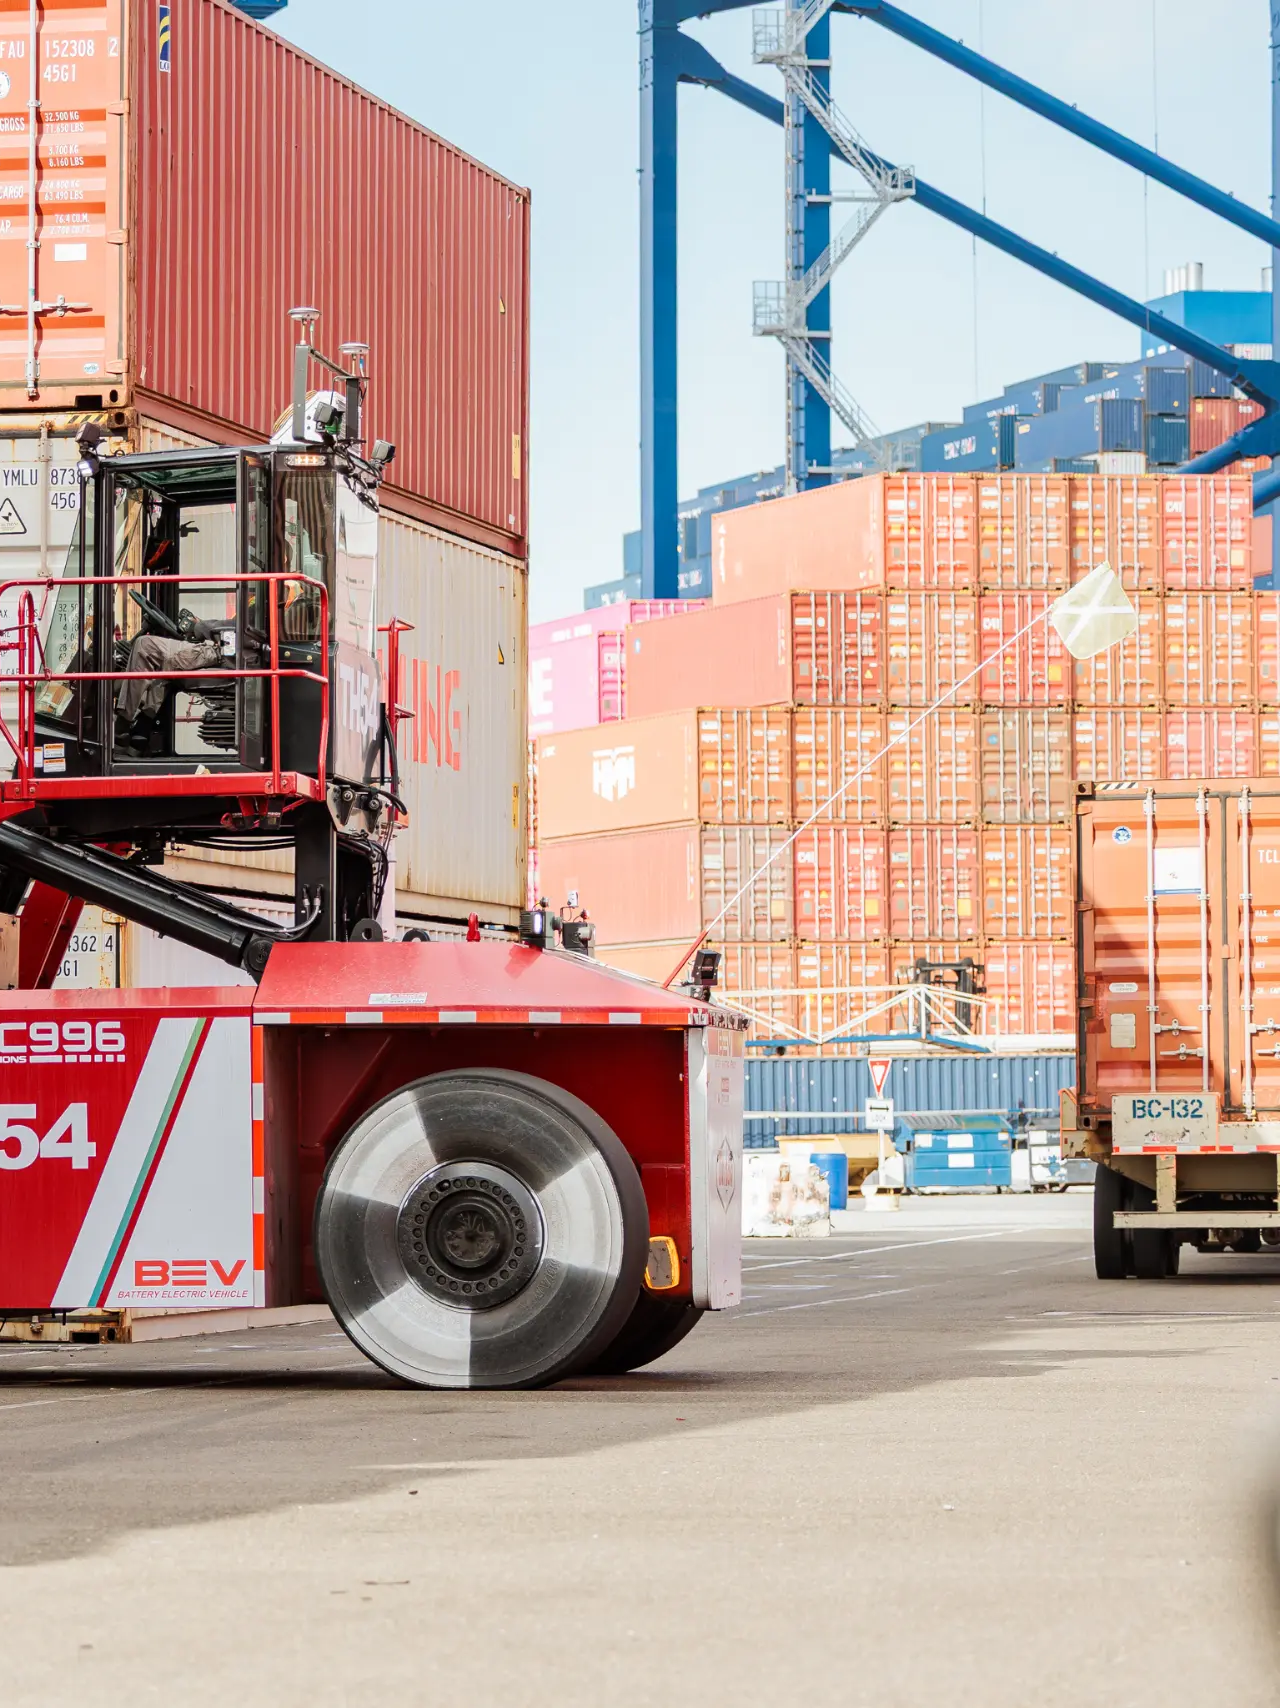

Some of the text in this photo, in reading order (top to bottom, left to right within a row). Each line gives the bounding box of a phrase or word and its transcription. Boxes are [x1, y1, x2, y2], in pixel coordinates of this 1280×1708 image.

[45, 38, 95, 58] 152308
[109, 38, 118, 56] 2
[44, 64, 77, 83] 45G1
[44, 110, 80, 123] 32.500 KG
[70, 122, 84, 133] LBS
[69, 144, 79, 154] KG
[48, 156, 85, 168] 8.160 LBS
[69, 190, 84, 200] LBS
[3, 468, 38, 486] YMLU
[1132, 1098, 1204, 1119] BC-132
[134, 1259, 247, 1287] BEV
[117, 1288, 249, 1299] BATTERY ELECTRIC VEHICLE
